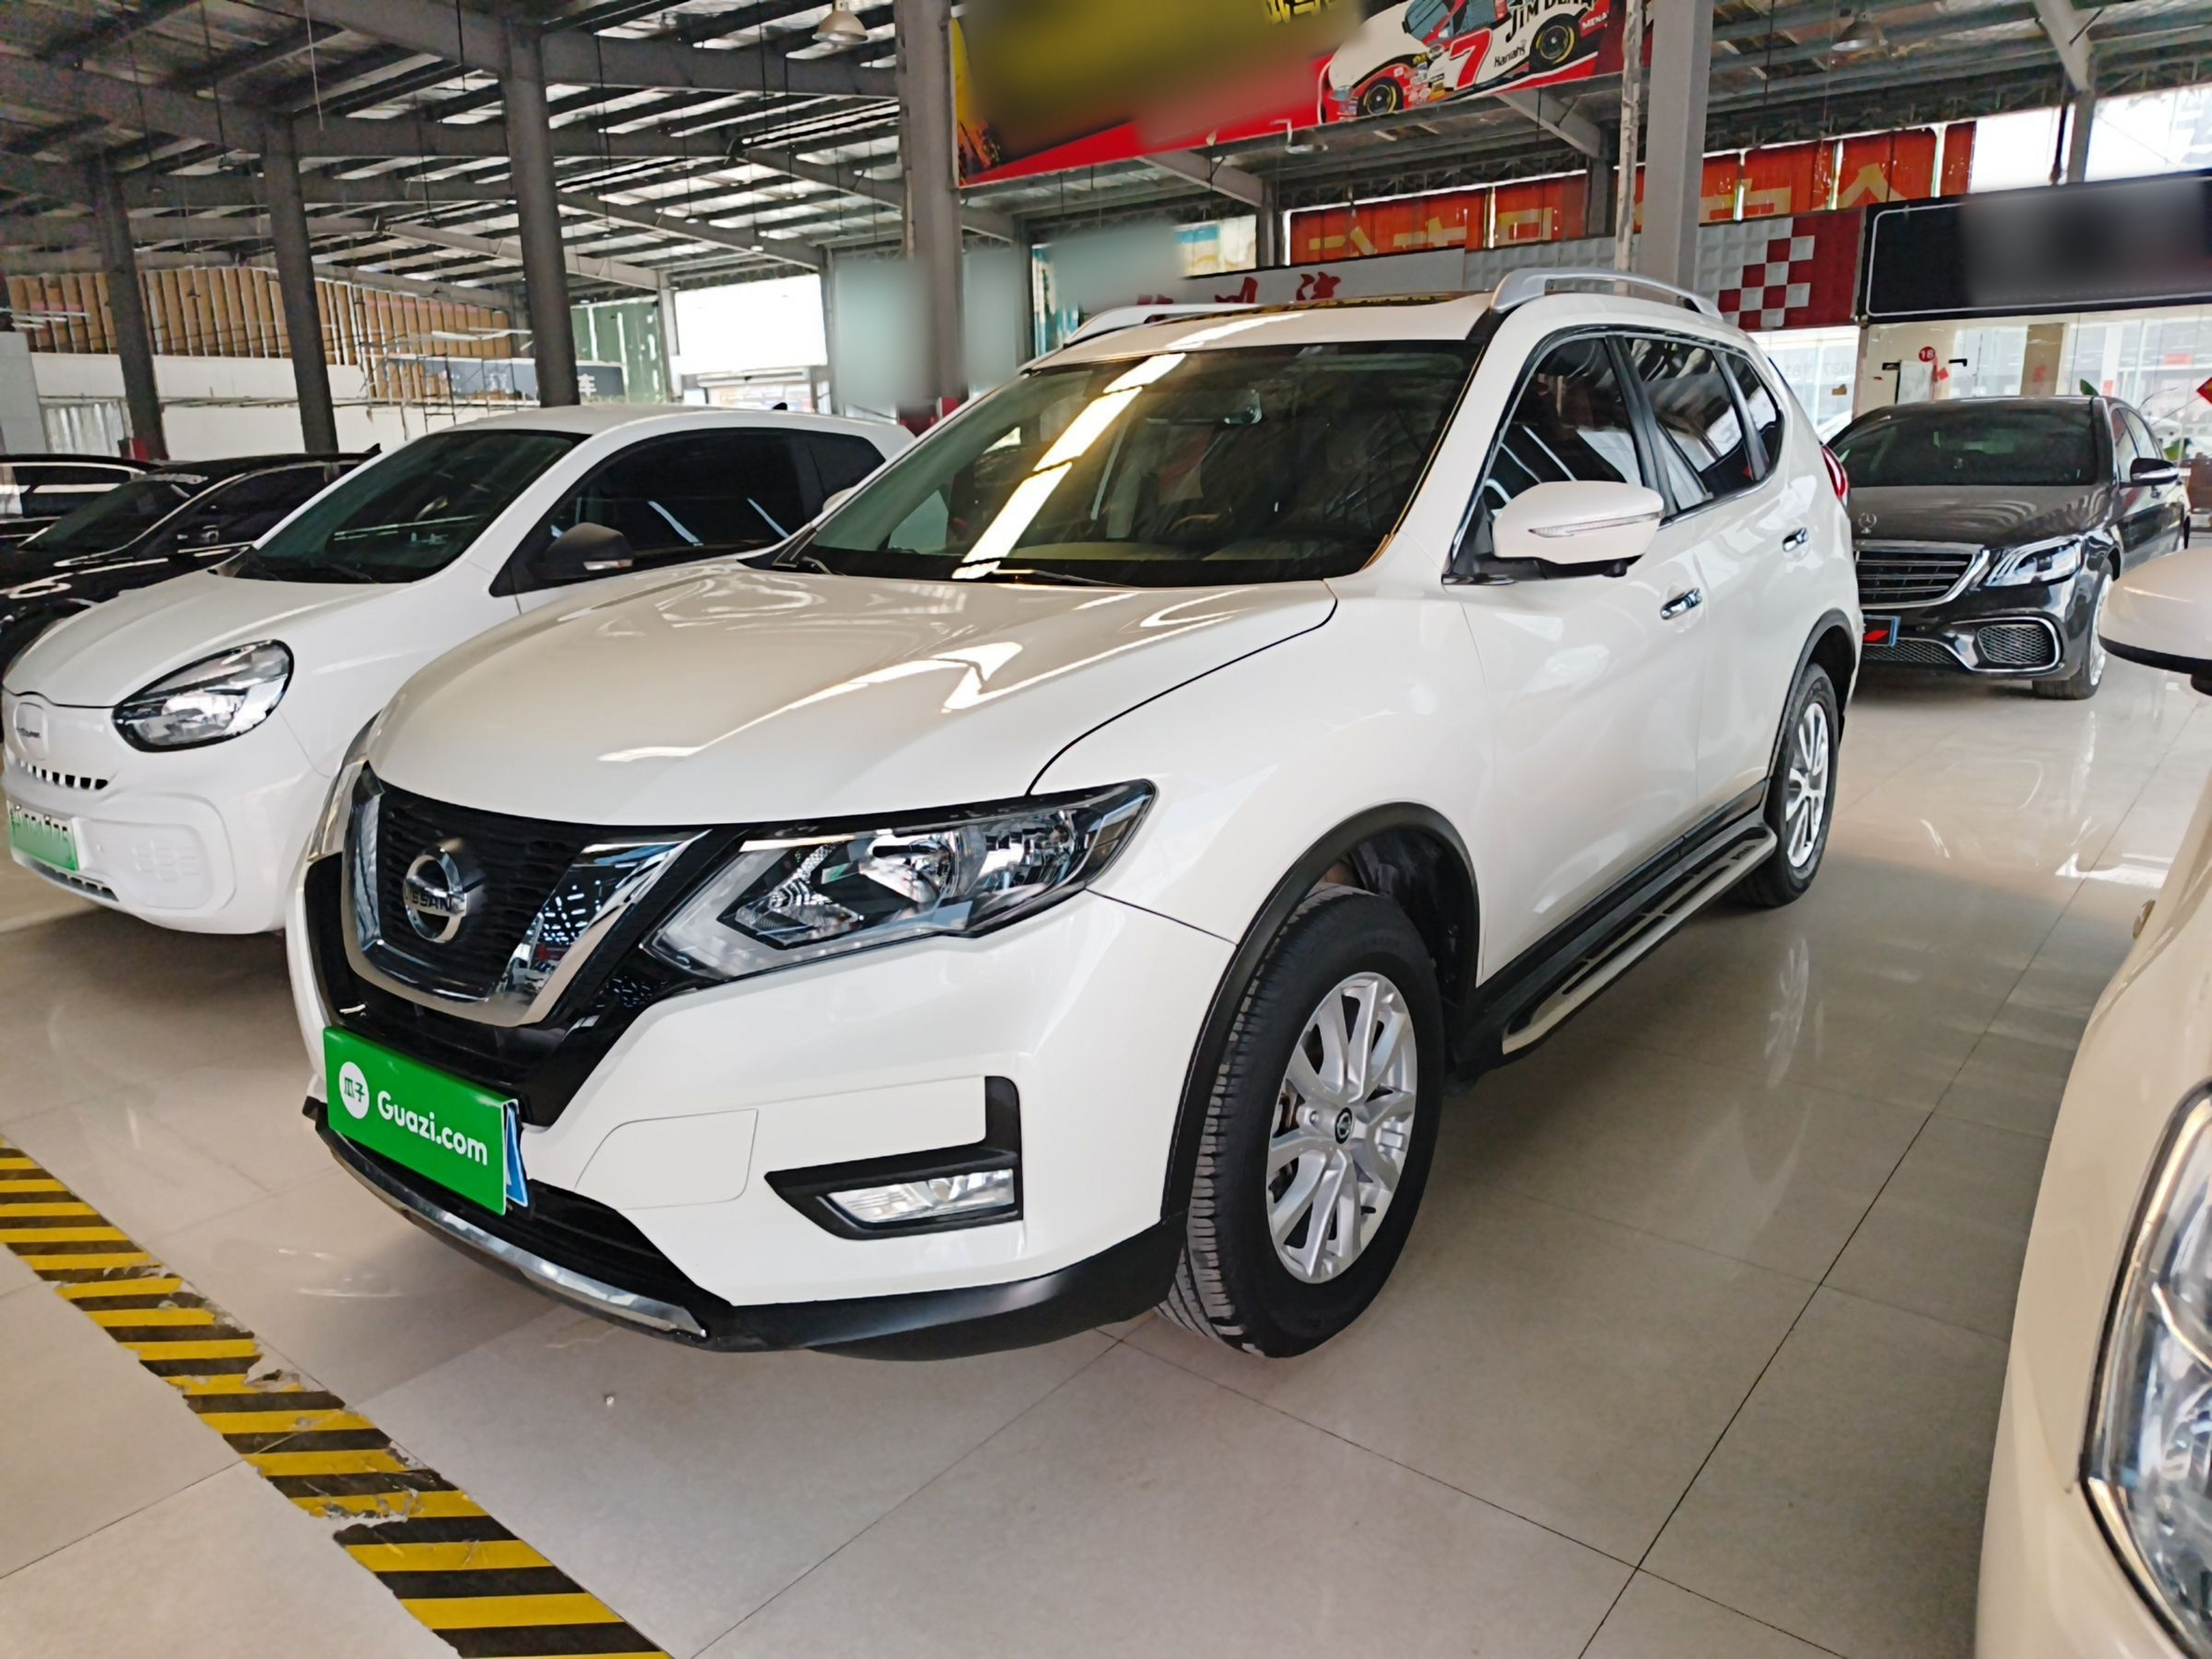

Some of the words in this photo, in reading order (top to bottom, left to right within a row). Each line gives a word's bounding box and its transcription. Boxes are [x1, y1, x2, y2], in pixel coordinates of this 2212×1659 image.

[1449, 28, 1493, 91] 7
[344, 1076, 365, 1103] 瓜子
[377, 1090, 488, 1166] Guazi.com
